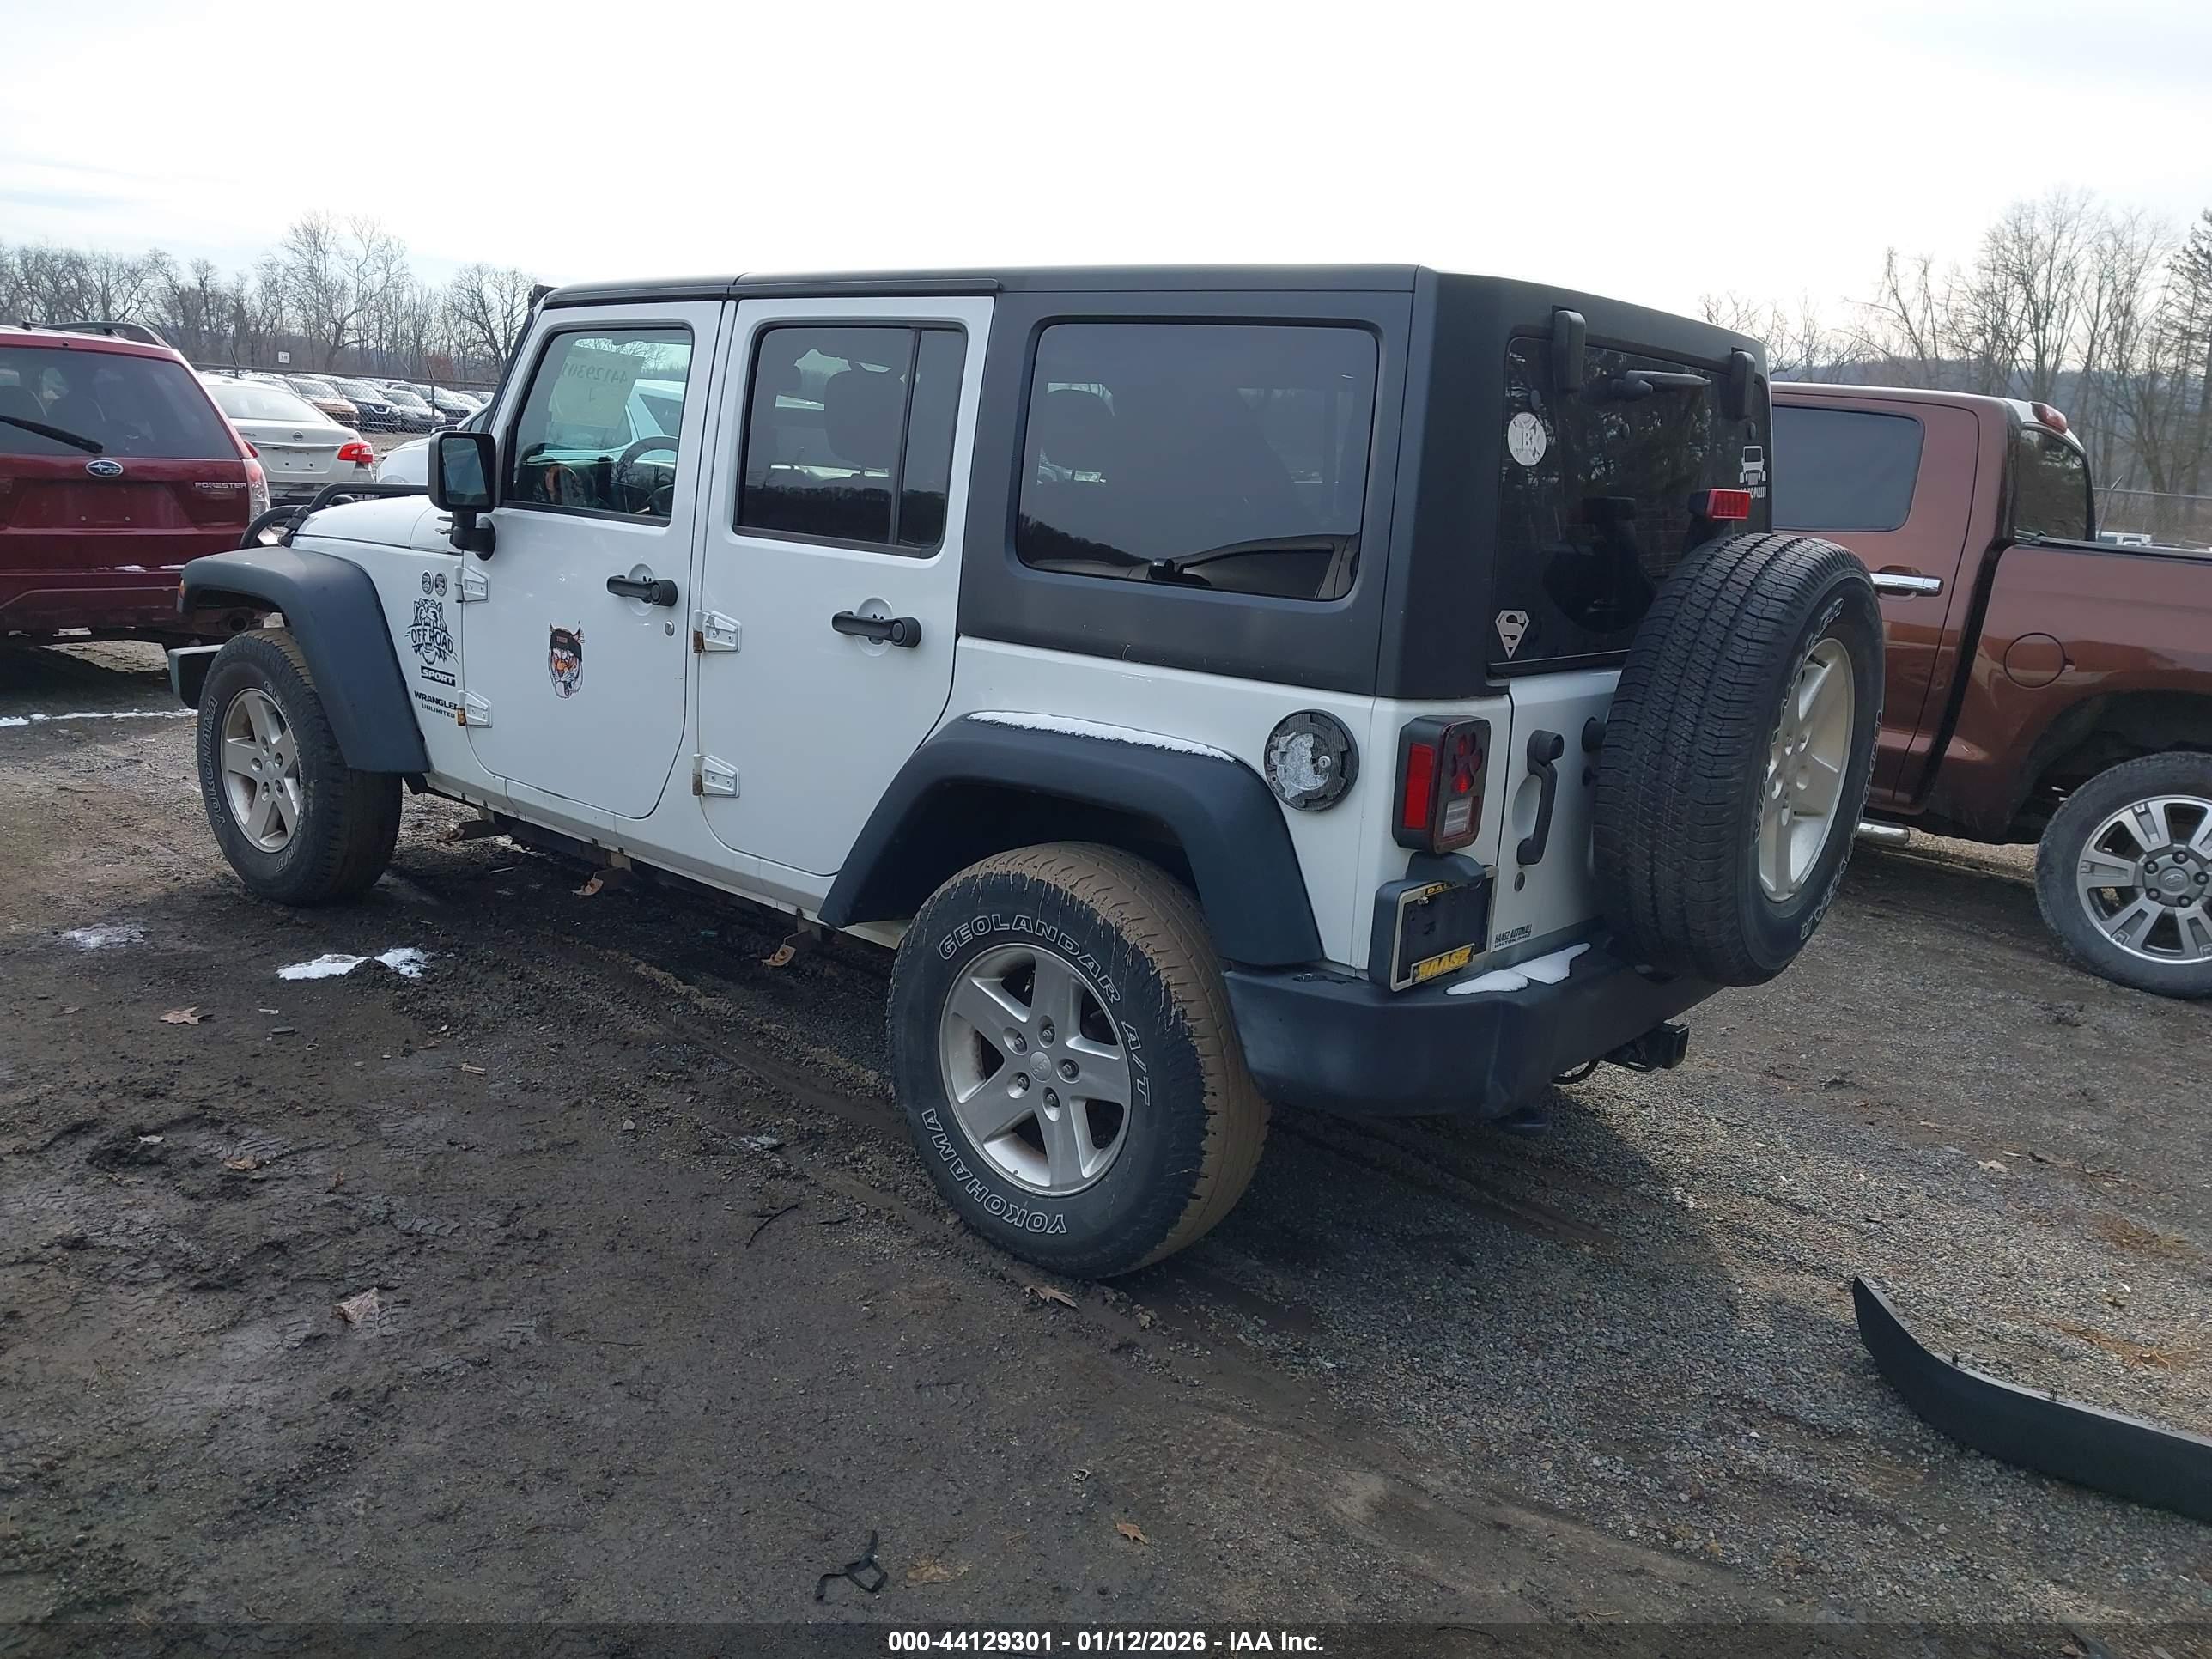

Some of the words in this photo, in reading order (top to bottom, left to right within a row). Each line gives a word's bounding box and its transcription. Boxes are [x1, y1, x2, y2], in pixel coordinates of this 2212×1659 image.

[422, 668, 455, 684] SPORT
[422, 703, 456, 719] UNLIMITED
[204, 696, 225, 827] YOKOHAMA
[939, 913, 1121, 1005] GEOLANDAR
[1121, 1020, 1152, 1106] A/T
[921, 1108, 1068, 1235] YOKOHAMA
